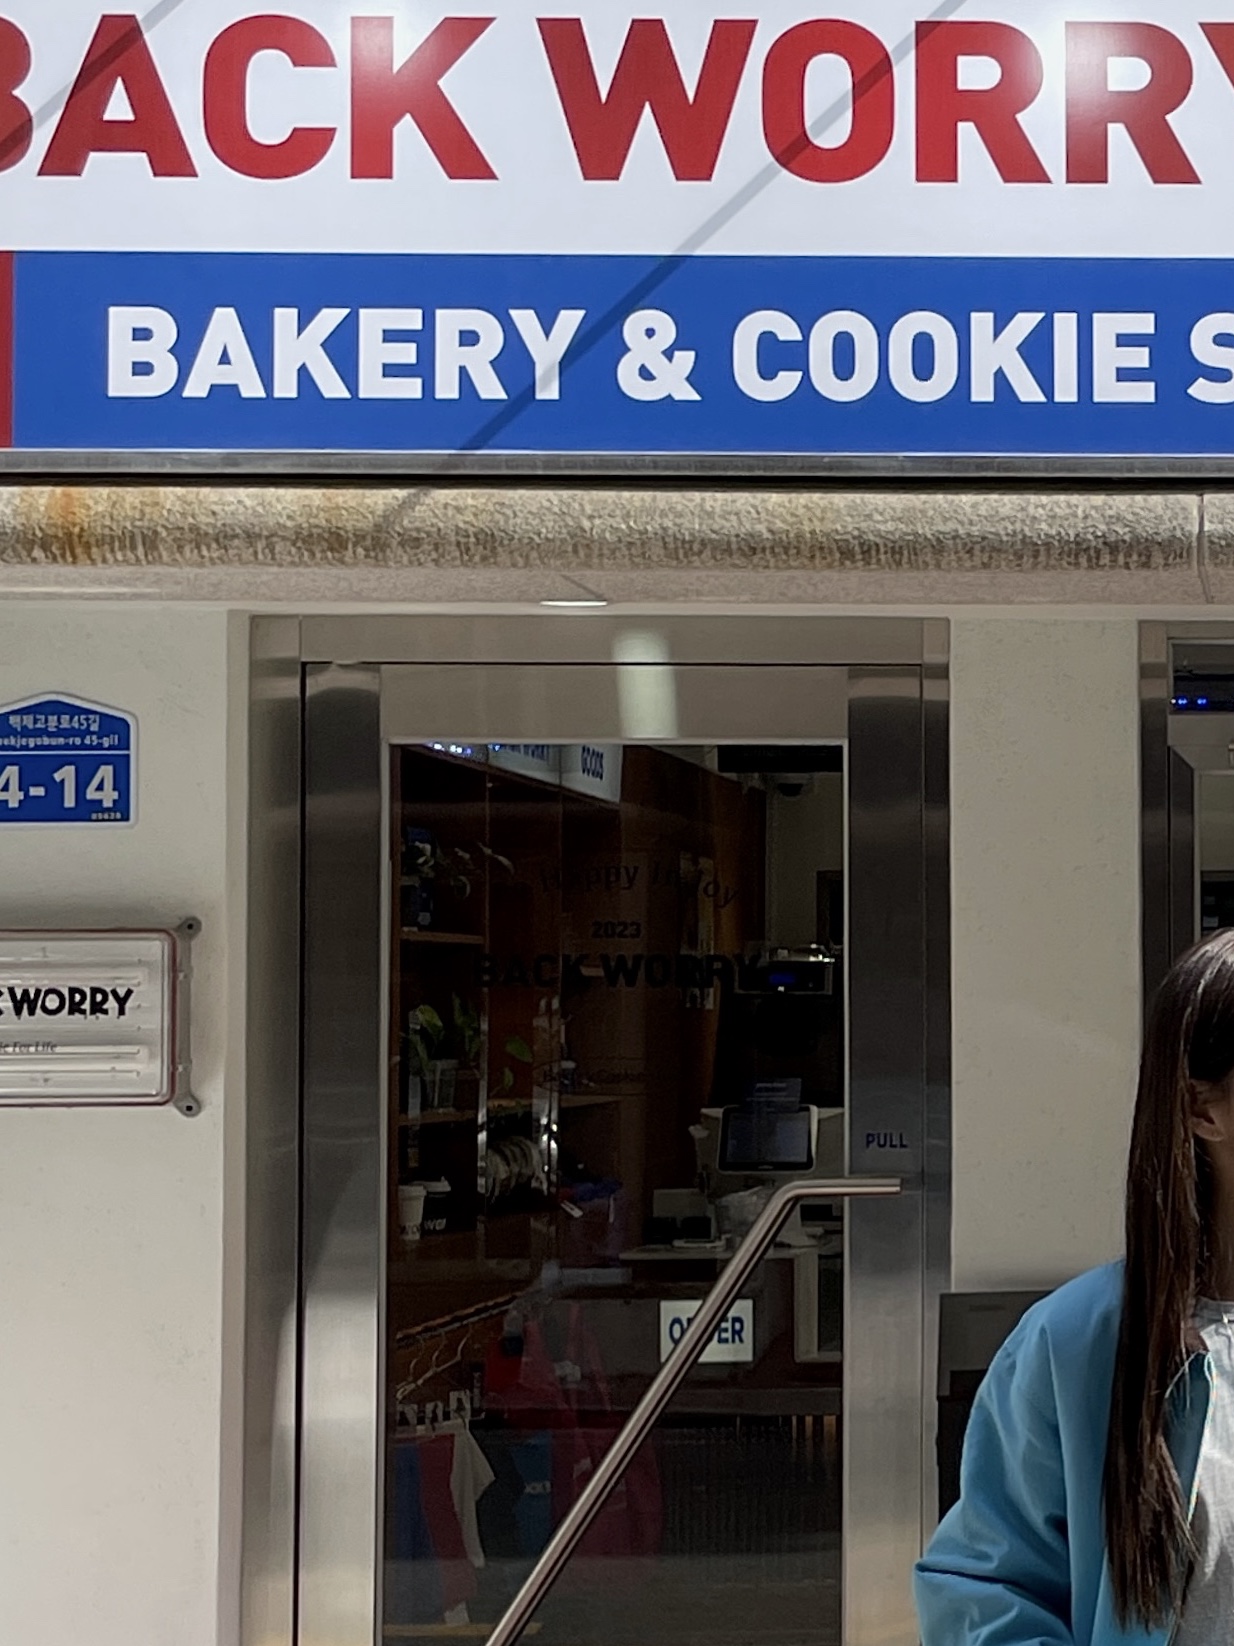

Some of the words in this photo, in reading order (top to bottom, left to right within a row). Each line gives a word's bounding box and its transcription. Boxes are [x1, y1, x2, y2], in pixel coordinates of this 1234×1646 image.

[0, 14, 498, 181] ACK
[107, 305, 586, 401] BAKERY
[615, 308, 702, 403] &
[731, 309, 1156, 404] COOKIE
[591, 920, 642, 939] 2023
[475, 952, 590, 988] BACK
[599, 952, 763, 989] WORRY
[7, 986, 134, 1016] WORRY
[865, 1132, 908, 1149] PULL
[668, 1316, 744, 1345] OER
